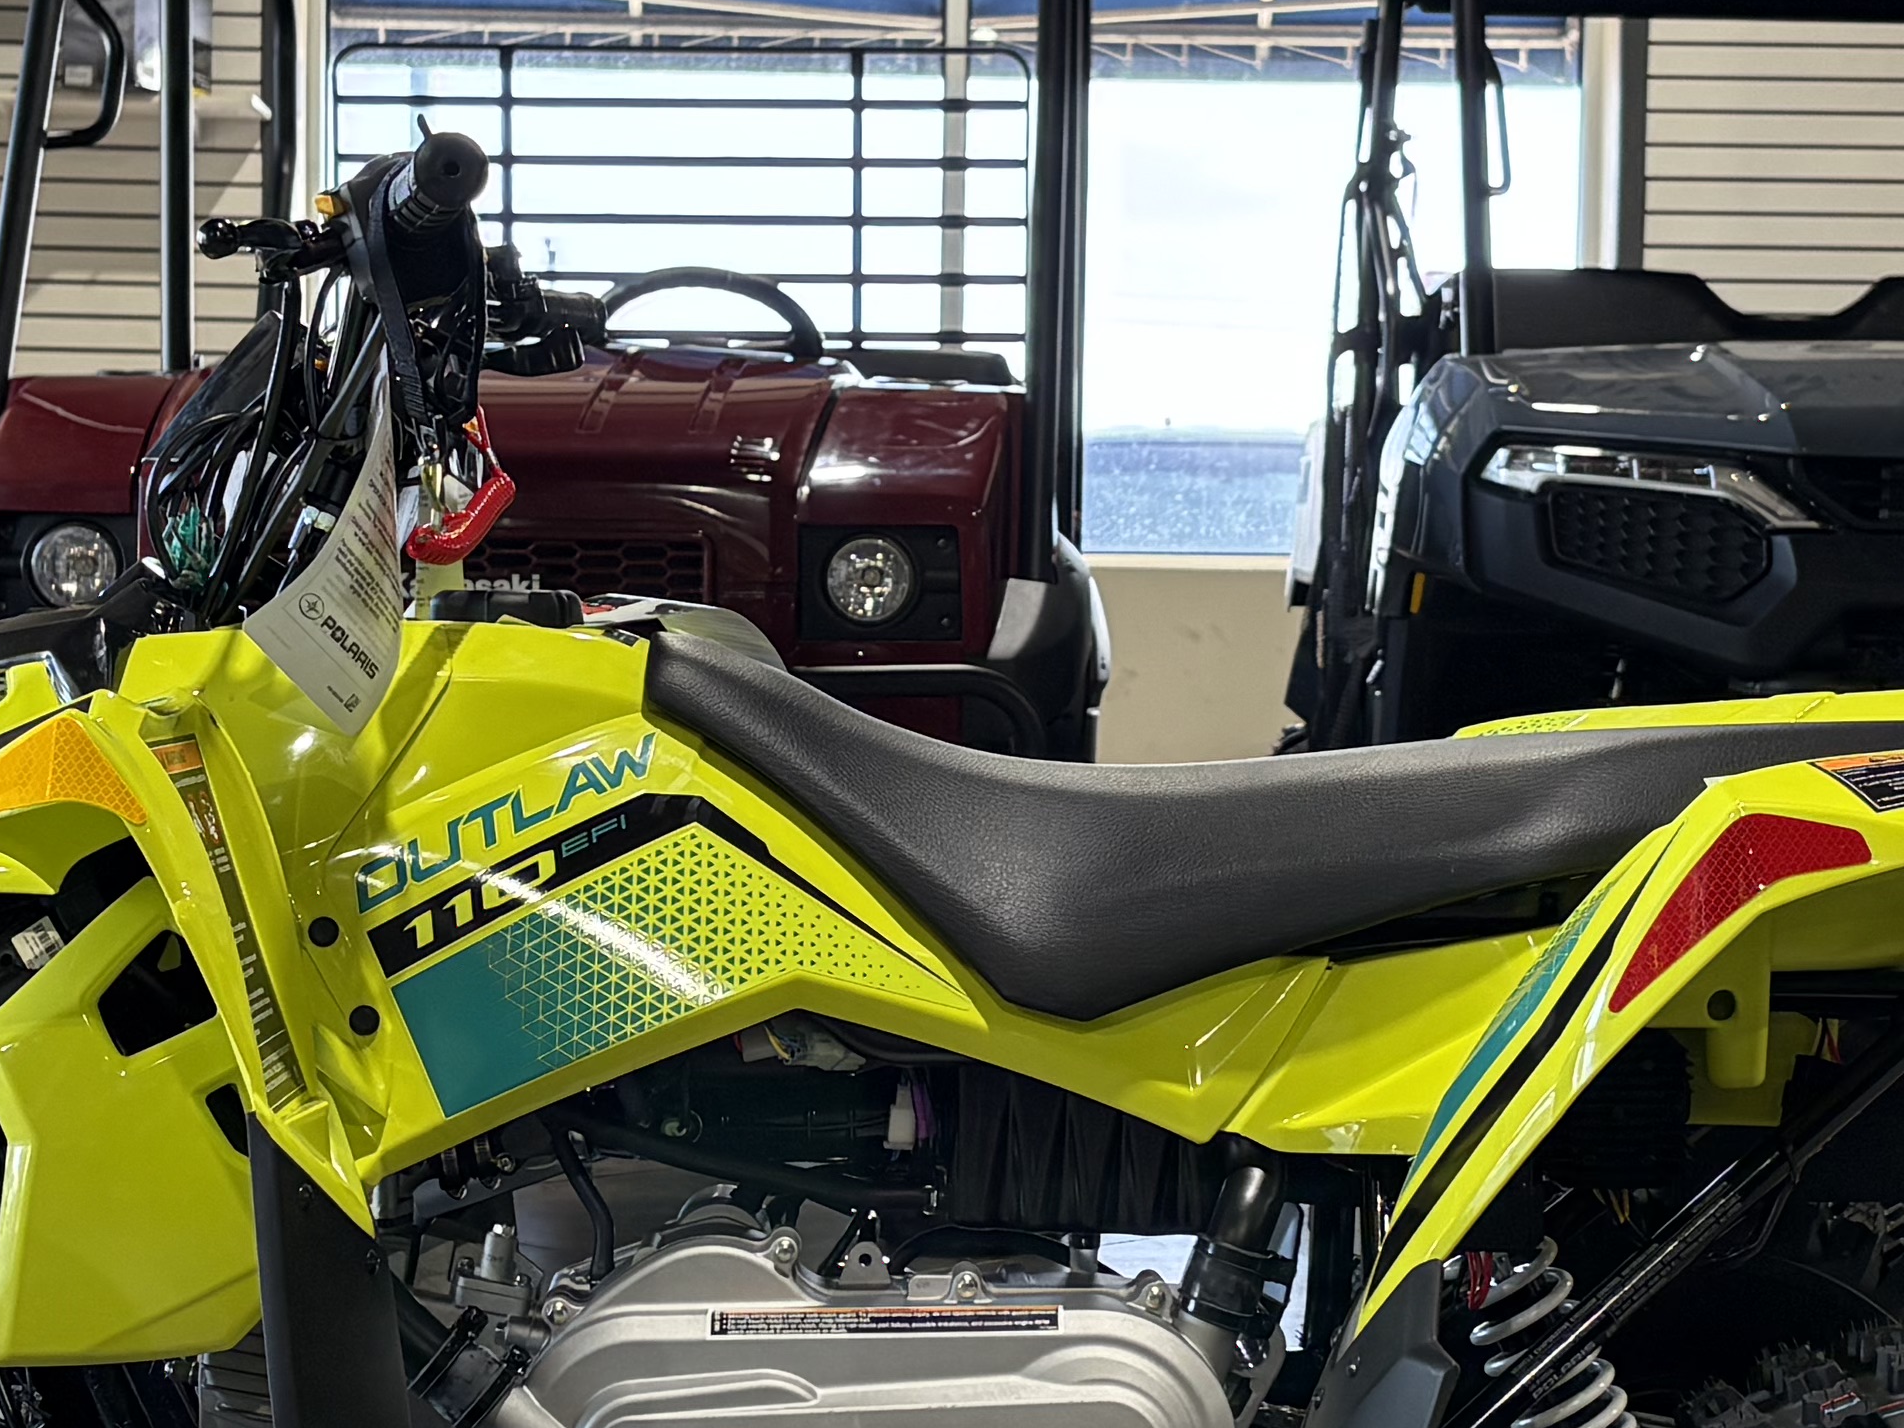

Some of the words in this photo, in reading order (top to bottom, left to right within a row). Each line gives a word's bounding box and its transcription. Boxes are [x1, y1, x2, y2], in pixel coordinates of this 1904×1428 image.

[400, 572, 541, 599] Ksaki
[321, 615, 381, 680] POLARIS
[356, 732, 656, 915] OUTLAW
[402, 850, 557, 950] 110
[560, 814, 627, 859] EFI
